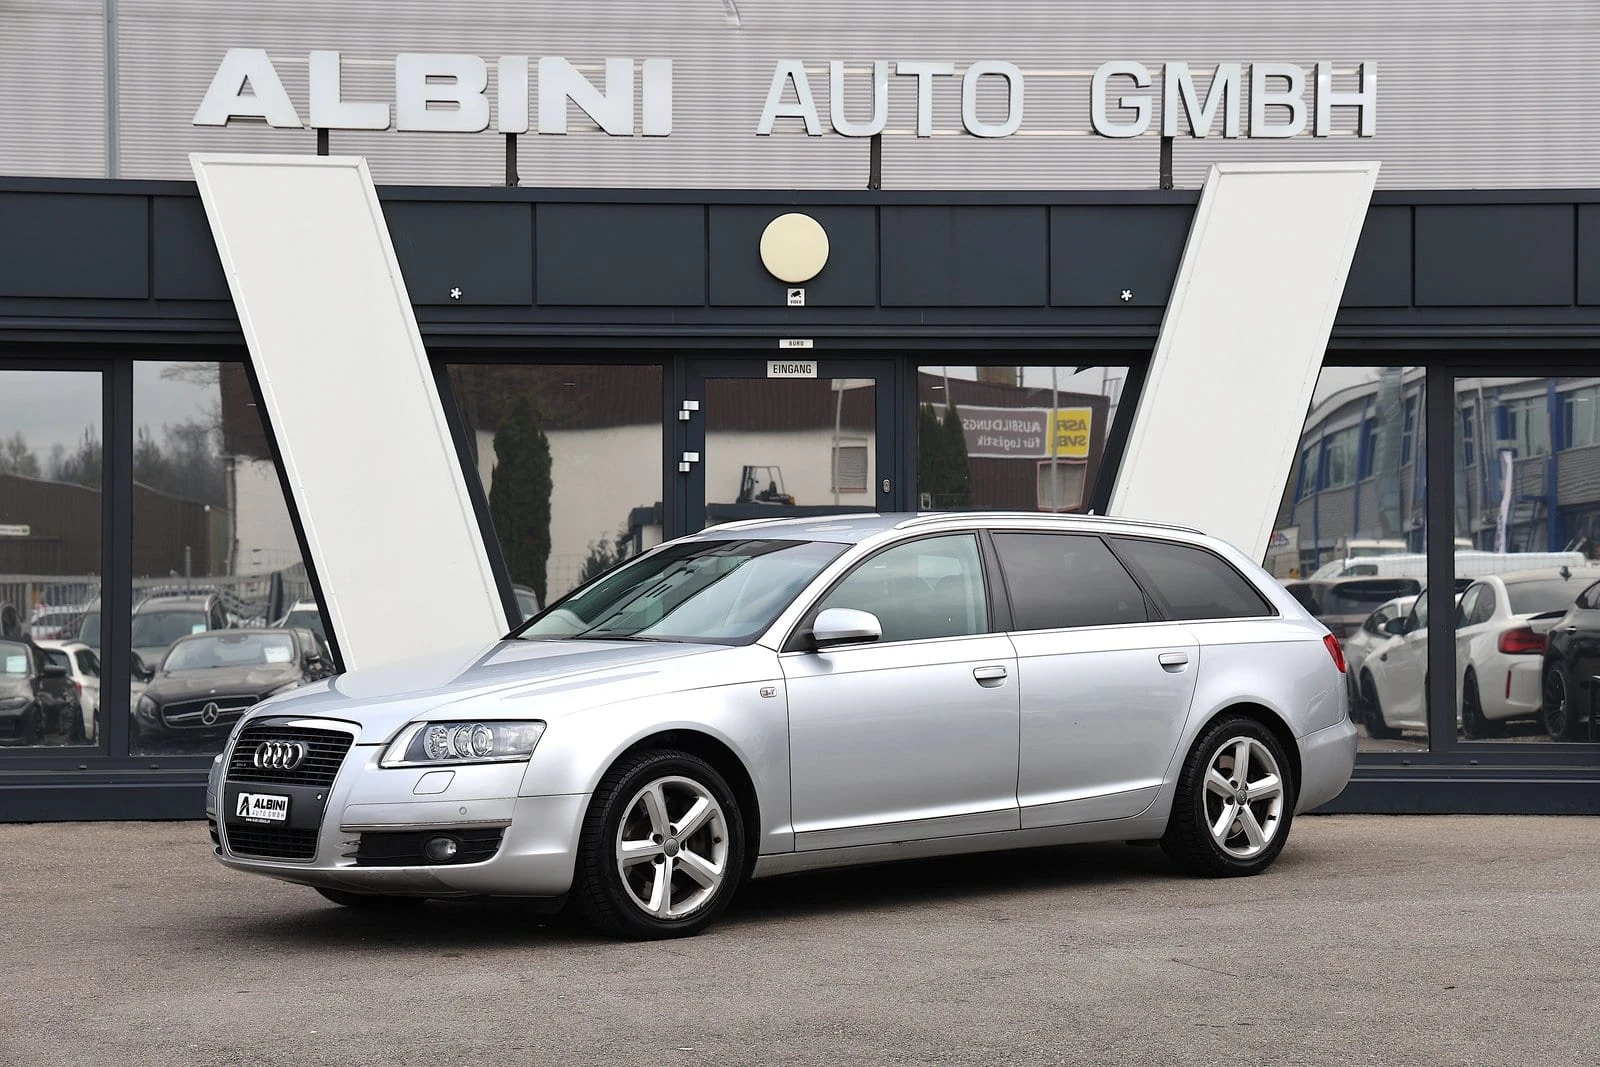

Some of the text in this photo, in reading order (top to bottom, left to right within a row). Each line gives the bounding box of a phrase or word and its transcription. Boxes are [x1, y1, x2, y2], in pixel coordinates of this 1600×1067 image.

[193, 48, 1378, 138] ALBINI AUTO GMBH
[773, 364, 812, 374] EINGANG
[253, 798, 286, 811] ALBINI
